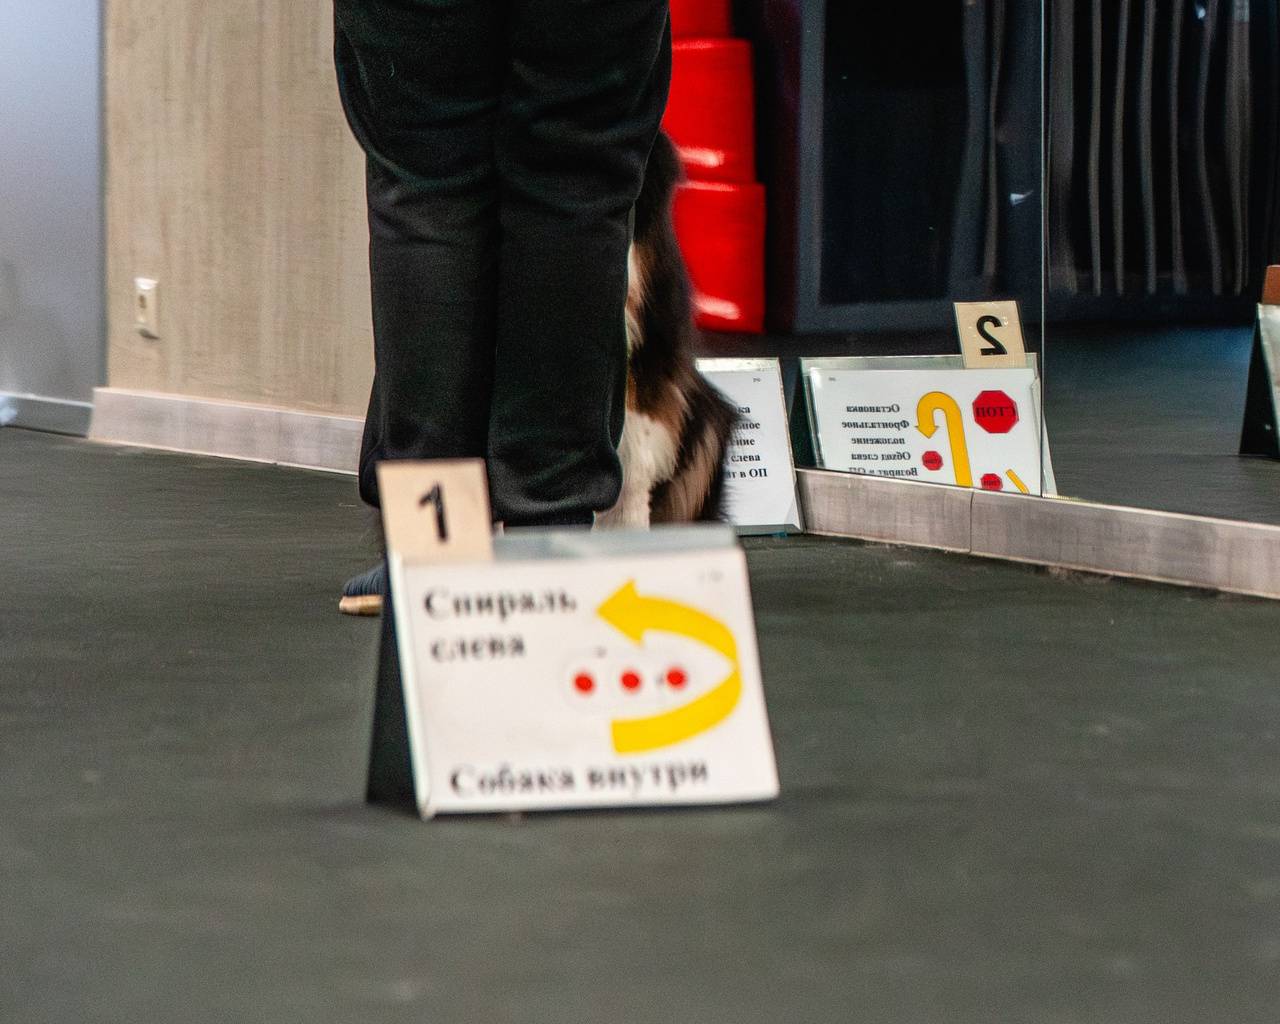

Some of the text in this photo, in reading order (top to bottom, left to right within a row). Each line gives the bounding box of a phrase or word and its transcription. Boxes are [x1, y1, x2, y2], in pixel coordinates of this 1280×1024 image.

[730, 454, 761, 463] слева
[749, 468, 768, 478] ОП
[419, 481, 448, 543] 1
[424, 587, 577, 620] Спираль
[431, 632, 525, 662] слева
[450, 760, 709, 798] Собака внутри
